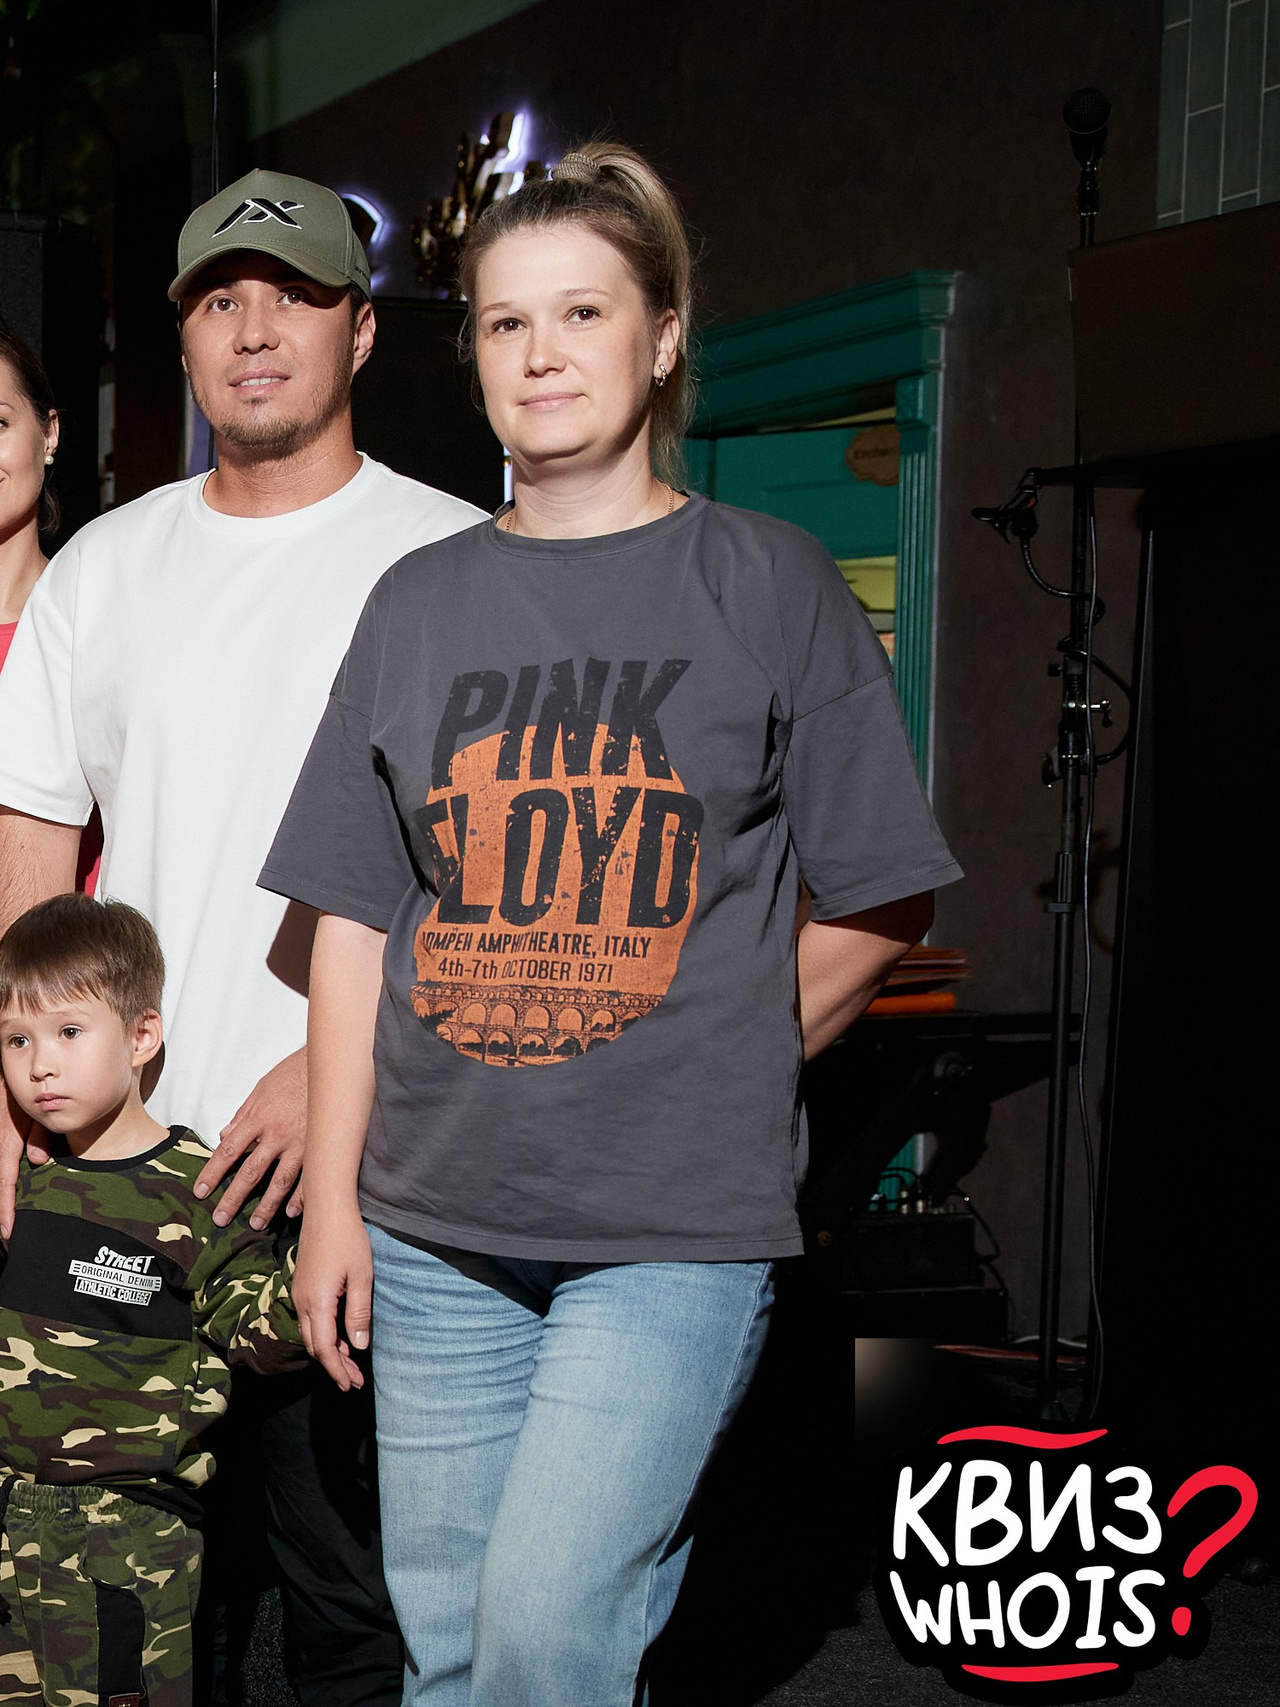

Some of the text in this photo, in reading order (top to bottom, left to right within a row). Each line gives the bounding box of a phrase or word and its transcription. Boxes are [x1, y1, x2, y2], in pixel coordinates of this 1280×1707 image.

[431, 657, 693, 791] PINK
[476, 931, 597, 958] AMPHITHEATRE,
[604, 935, 652, 958] ITALY
[437, 956, 613, 983] 4th-7th OCTOBER 1971
[94, 1245, 155, 1274] STREET
[81, 1265, 154, 1288] ORIGINAL DENIM
[78, 1280, 149, 1303] ATHLETIC COLLEGE
